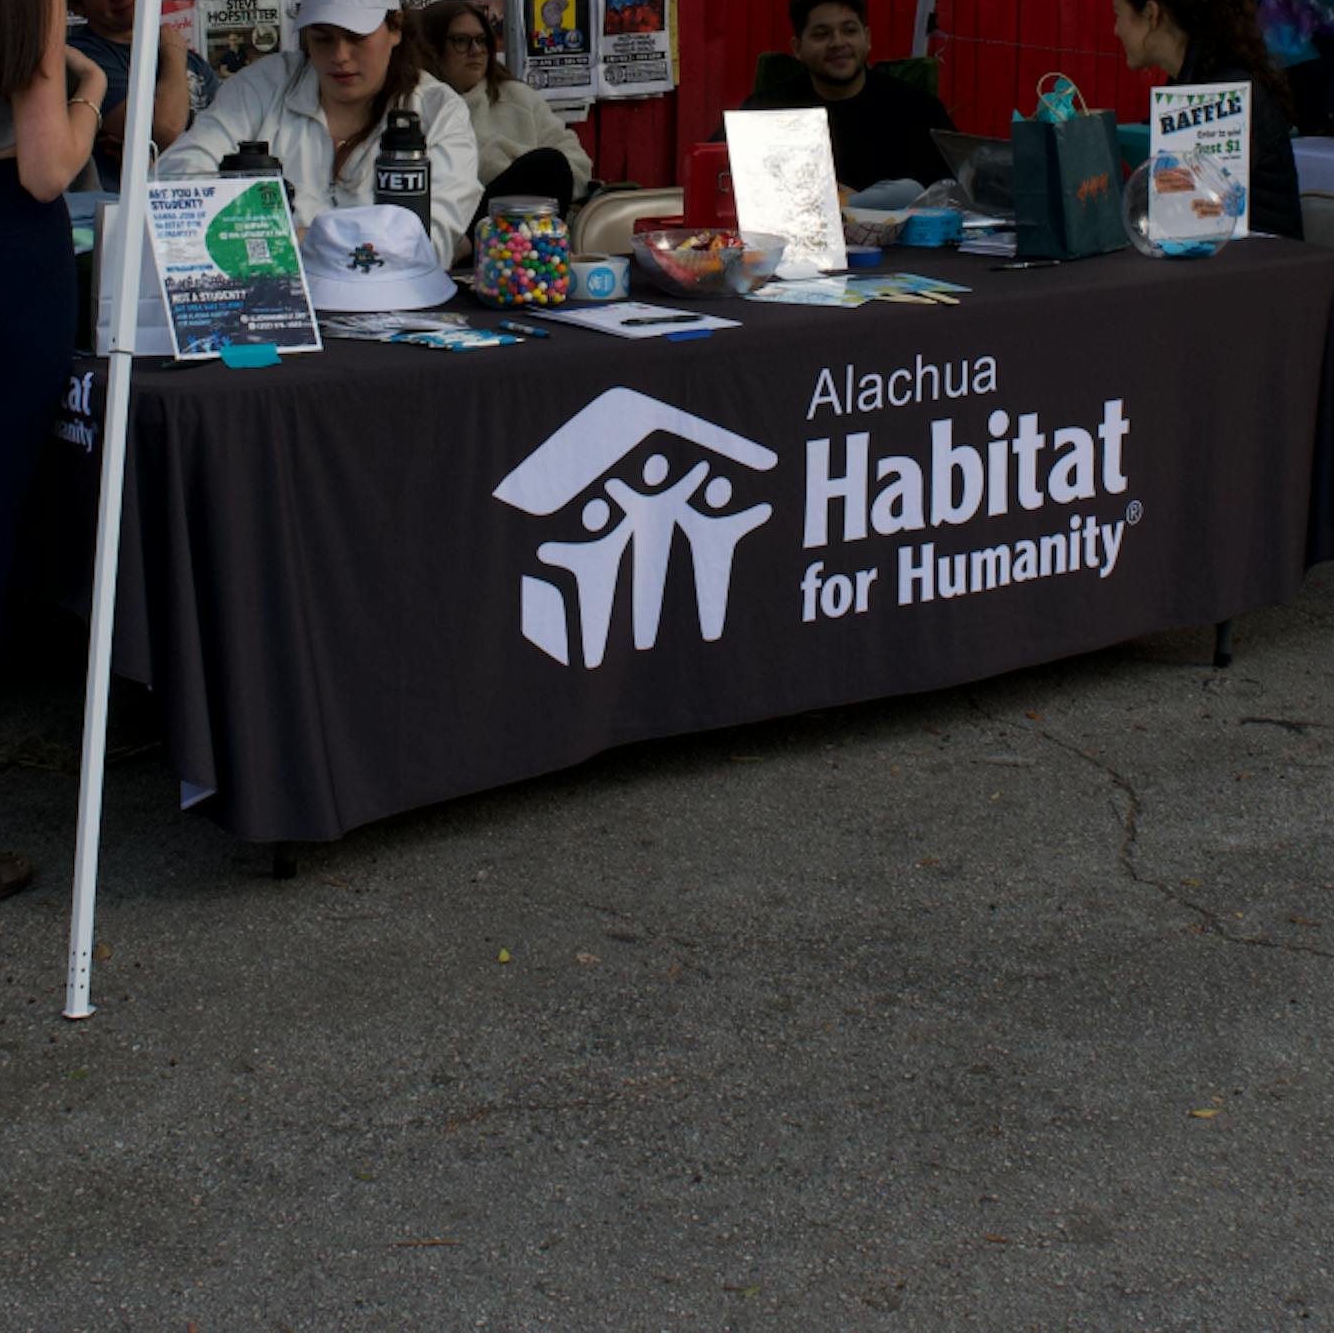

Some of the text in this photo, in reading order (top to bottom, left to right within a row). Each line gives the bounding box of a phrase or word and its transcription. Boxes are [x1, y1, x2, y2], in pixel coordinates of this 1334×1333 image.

[207, 9, 278, 23] HOFSTETTER
[1161, 96, 1242, 135] RAFFLE
[1225, 139, 1241, 155] $1
[377, 171, 425, 190] YETI
[172, 187, 192, 199] YOU
[151, 198, 204, 211] STUDENT?
[805, 353, 999, 421] Alachua
[800, 398, 1131, 550] Habitat
[800, 516, 1126, 624] for Humanity
